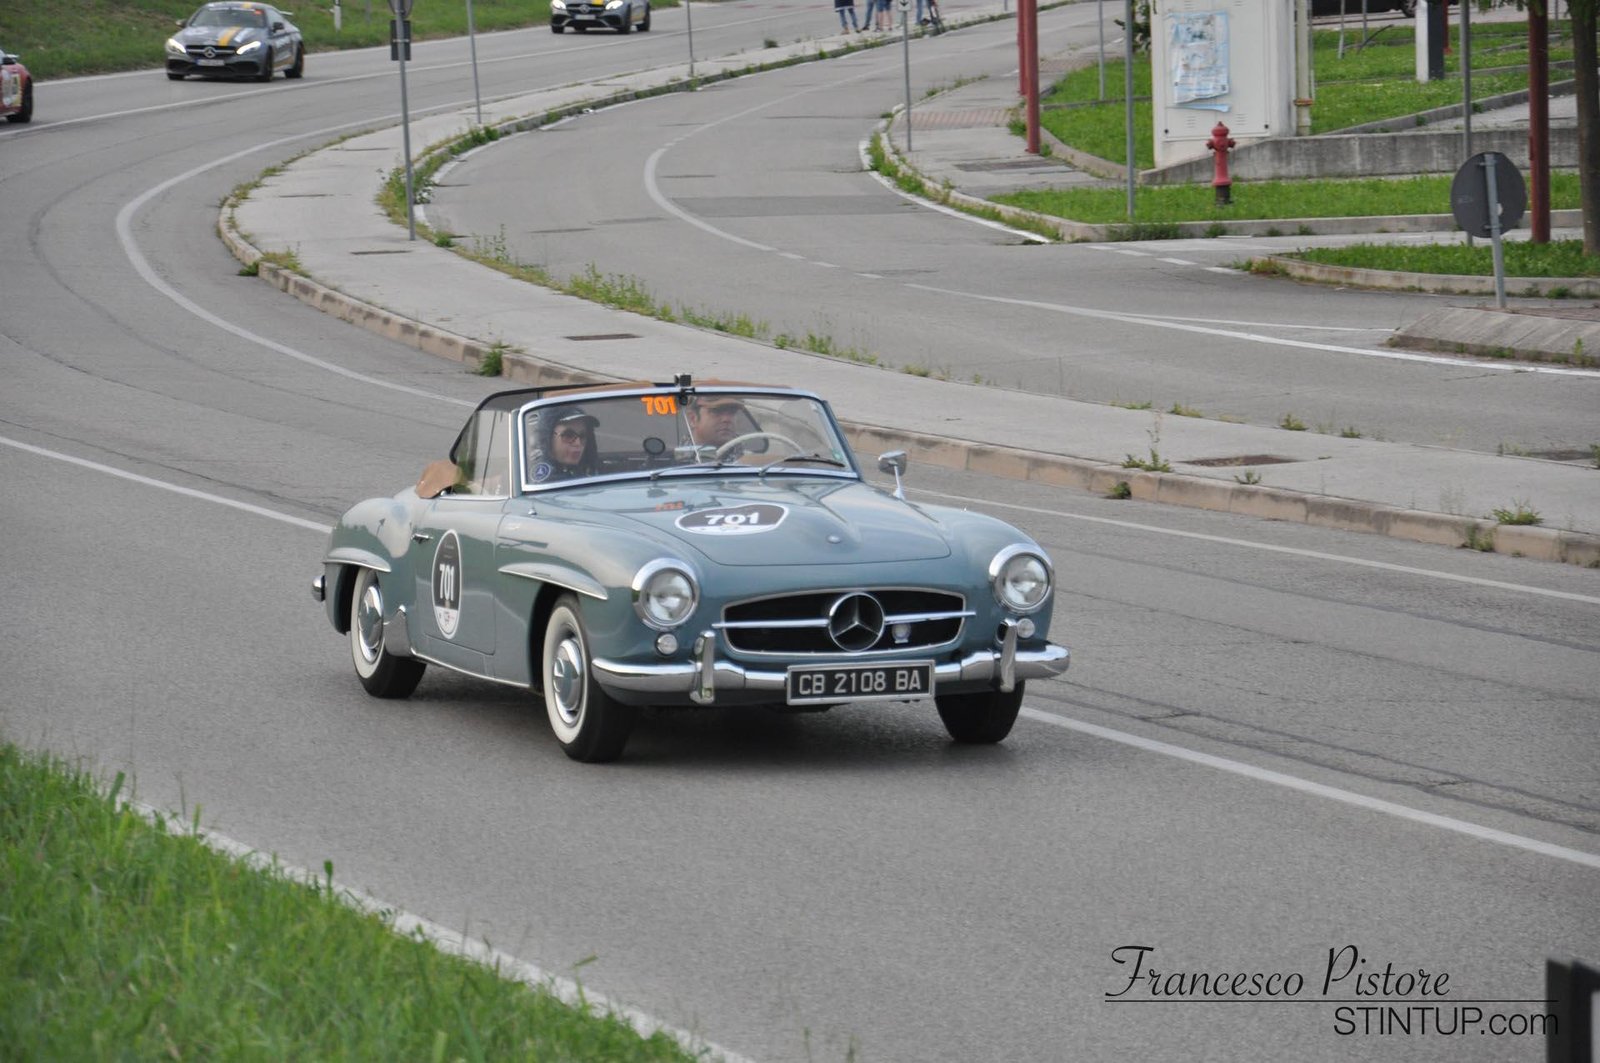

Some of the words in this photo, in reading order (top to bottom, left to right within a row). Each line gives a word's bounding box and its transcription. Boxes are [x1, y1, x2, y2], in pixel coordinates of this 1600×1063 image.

[641, 395, 677, 416] 701
[704, 511, 760, 525] 701
[439, 563, 455, 601] 701
[799, 674, 825, 695] CB
[834, 671, 886, 694] 2108
[895, 669, 921, 691] BA
